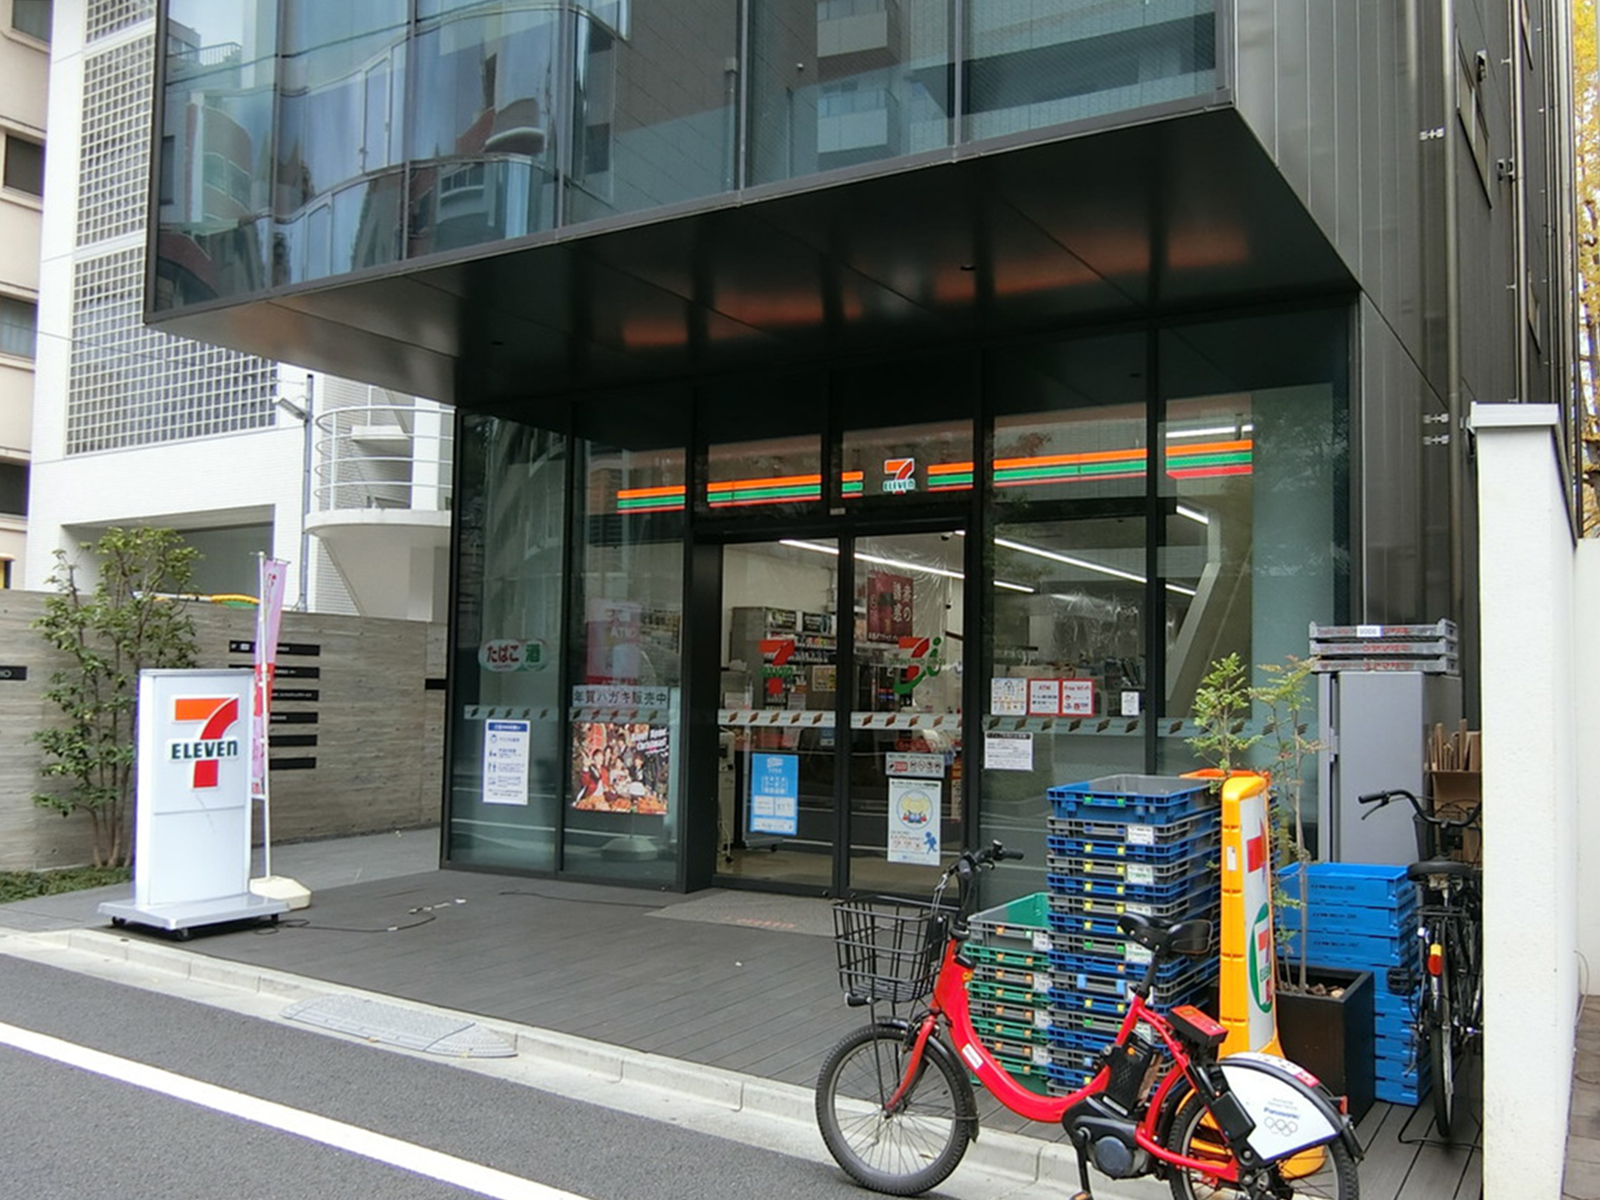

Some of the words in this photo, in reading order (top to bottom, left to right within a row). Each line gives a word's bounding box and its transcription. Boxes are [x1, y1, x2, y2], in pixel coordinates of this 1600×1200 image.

[884, 459, 914, 495] 7
[486, 645, 520, 663] たばこ
[574, 691, 668, 706] 年賀ハガキ販売中
[174, 697, 239, 788] 7
